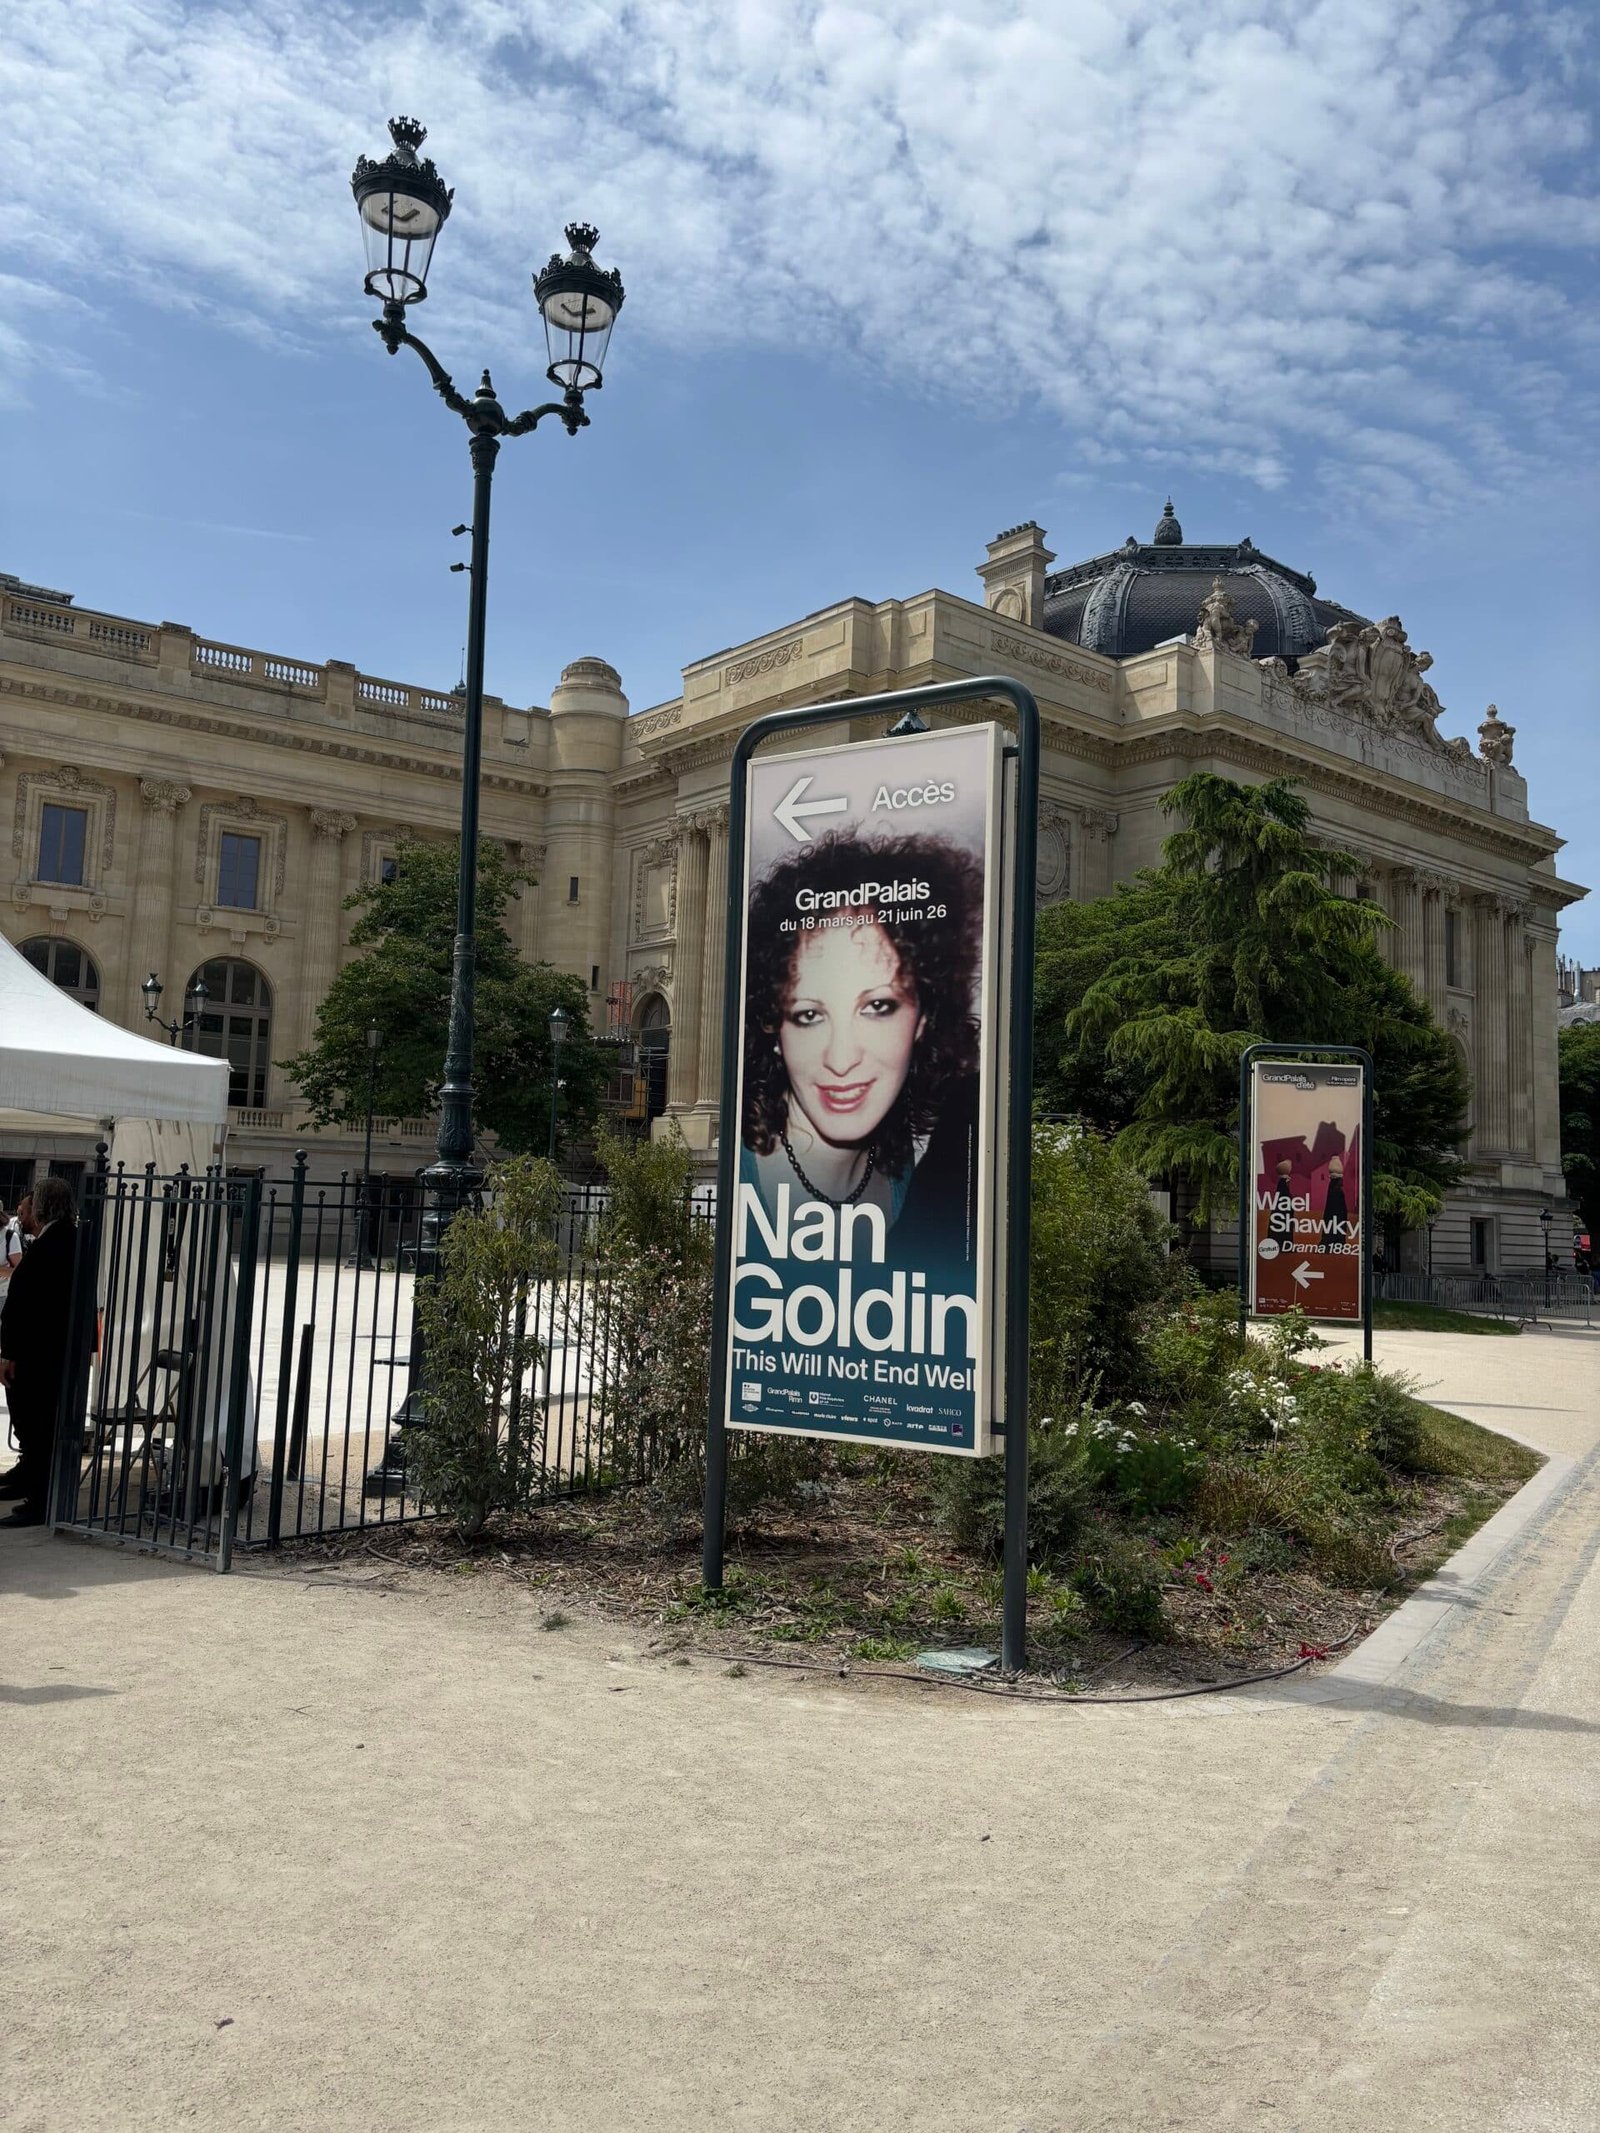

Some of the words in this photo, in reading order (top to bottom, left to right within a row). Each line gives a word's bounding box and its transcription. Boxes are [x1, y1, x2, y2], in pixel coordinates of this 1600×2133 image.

[872, 780, 955, 812] Accès
[795, 878, 930, 911] GrandPalais
[780, 919, 797, 932] du
[800, 917, 815, 930] 18
[818, 915, 853, 929] mars
[856, 914, 874, 925] au
[877, 910, 893, 924] 21
[895, 908, 923, 924] juin
[926, 905, 947, 919] 26
[1256, 1191, 1310, 1212] Wael
[736, 1183, 886, 1263] Nan
[1269, 1212, 1360, 1239] Shawky
[1281, 1241, 1325, 1254] Drama
[1328, 1243, 1360, 1256] 1882
[733, 1262, 977, 1359] Goldin
[733, 1348, 776, 1372] This
[781, 1352, 822, 1376] Will
[827, 1356, 868, 1381] Not
[874, 1360, 919, 1386] End
[924, 1364, 977, 1392] Well
[863, 1394, 898, 1405] CHANEL
[906, 1404, 934, 1414] kvadrat
